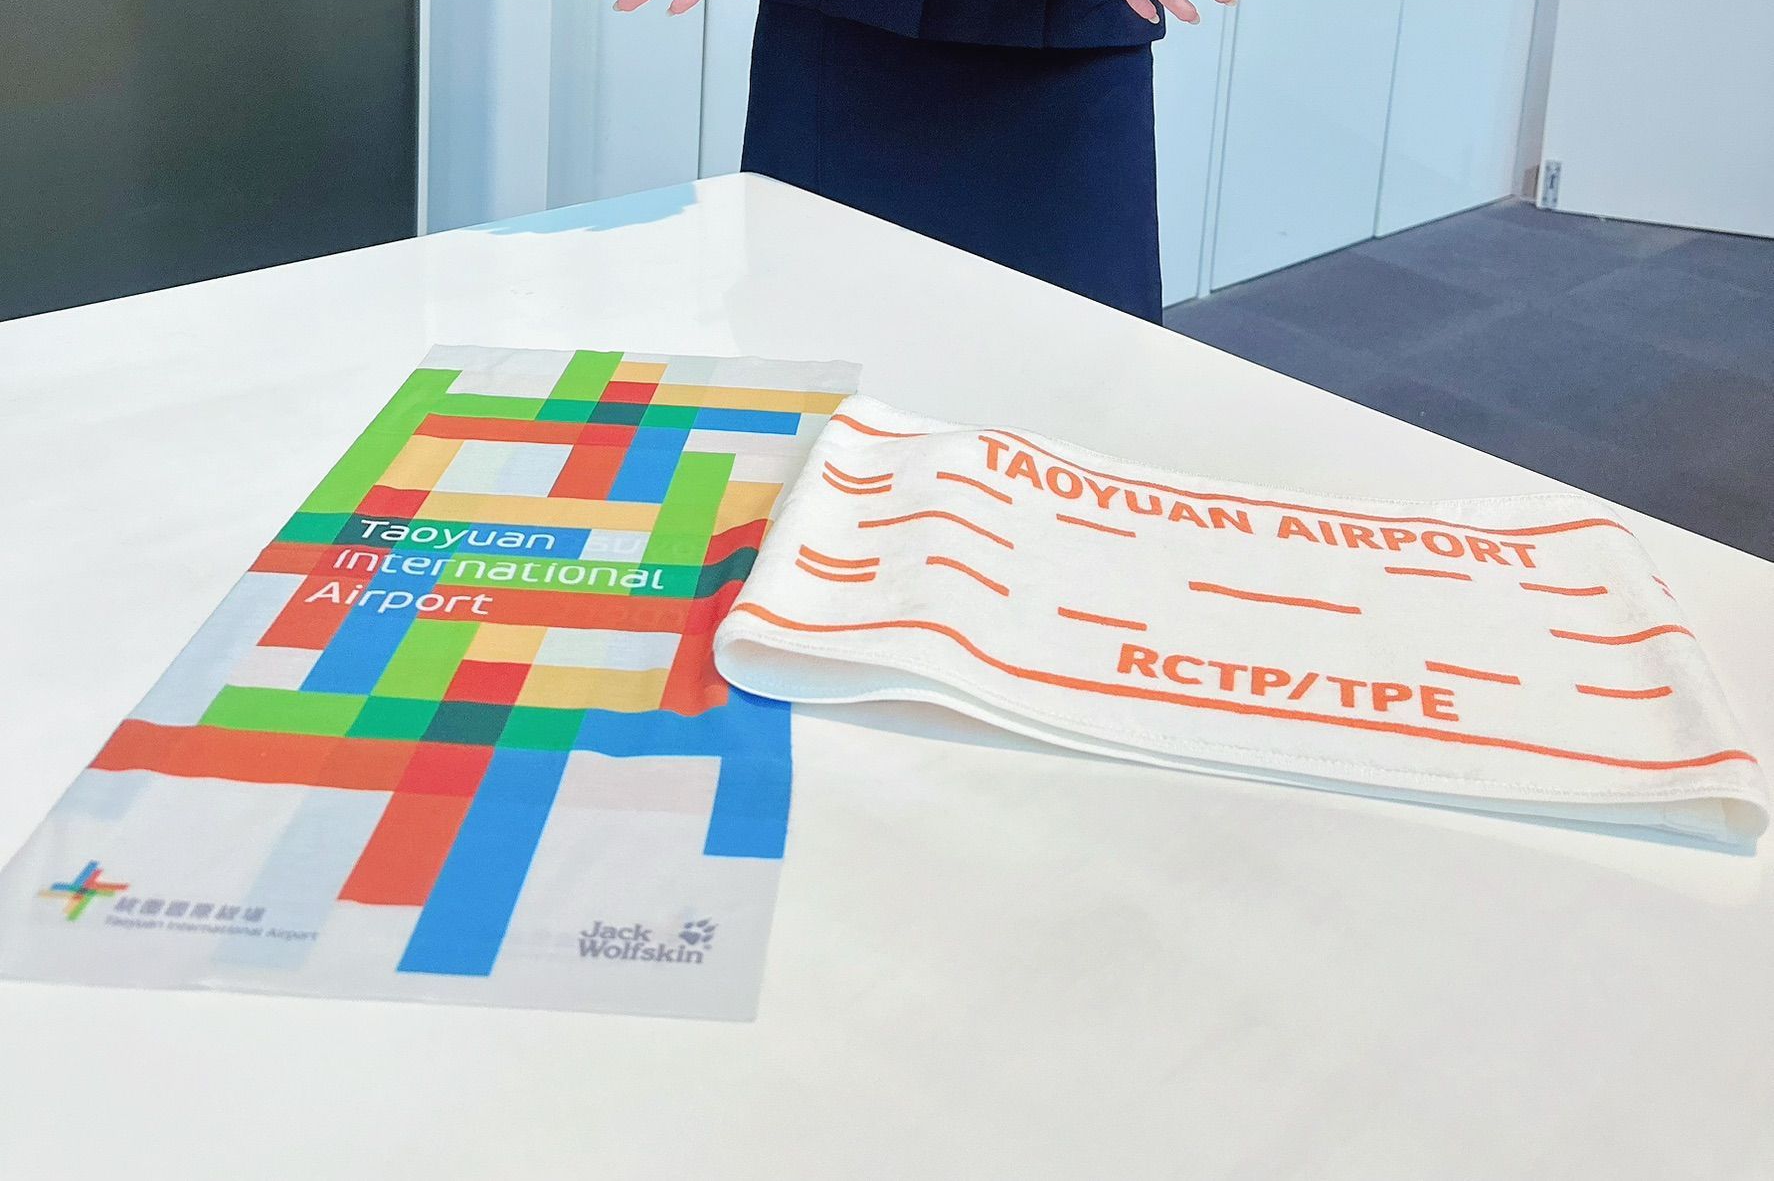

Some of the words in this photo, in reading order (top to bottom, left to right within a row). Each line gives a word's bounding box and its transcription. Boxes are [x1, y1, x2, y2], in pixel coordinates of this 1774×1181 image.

[978, 435, 1254, 534] TAOYUAN
[1277, 515, 1536, 568] AIRPORT
[360, 519, 556, 550] Taoyuan
[332, 549, 664, 591] International
[304, 581, 494, 615] Airport
[1116, 643, 1460, 722] RCTP/TPE
[580, 920, 652, 942] Jack
[579, 938, 704, 964] Wolfskin
